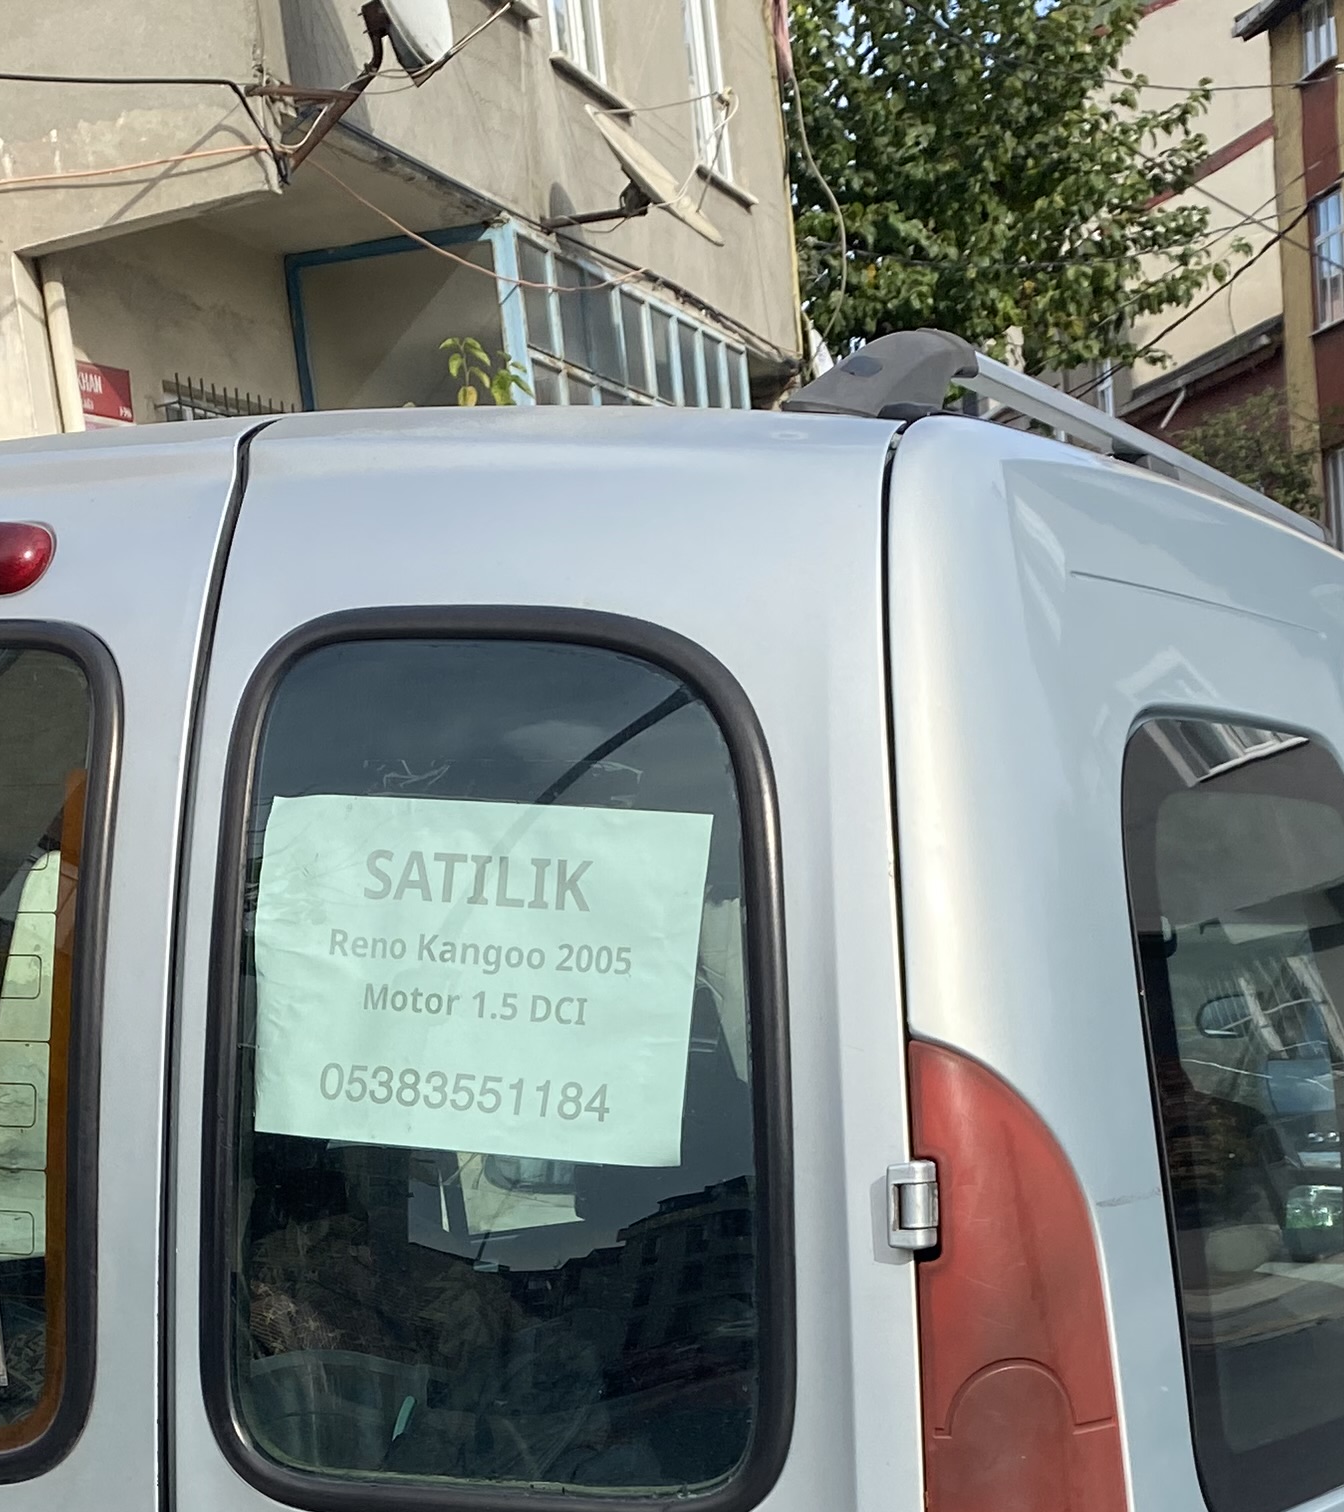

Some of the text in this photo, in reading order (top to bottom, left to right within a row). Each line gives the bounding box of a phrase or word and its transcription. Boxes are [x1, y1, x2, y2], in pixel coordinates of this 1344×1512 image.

[364, 849, 594, 912] SATILIK
[328, 928, 633, 975] Reno Kangoo 2005
[362, 983, 588, 1027] Motor 1.5 DCI
[319, 1062, 611, 1123] 05383551184
